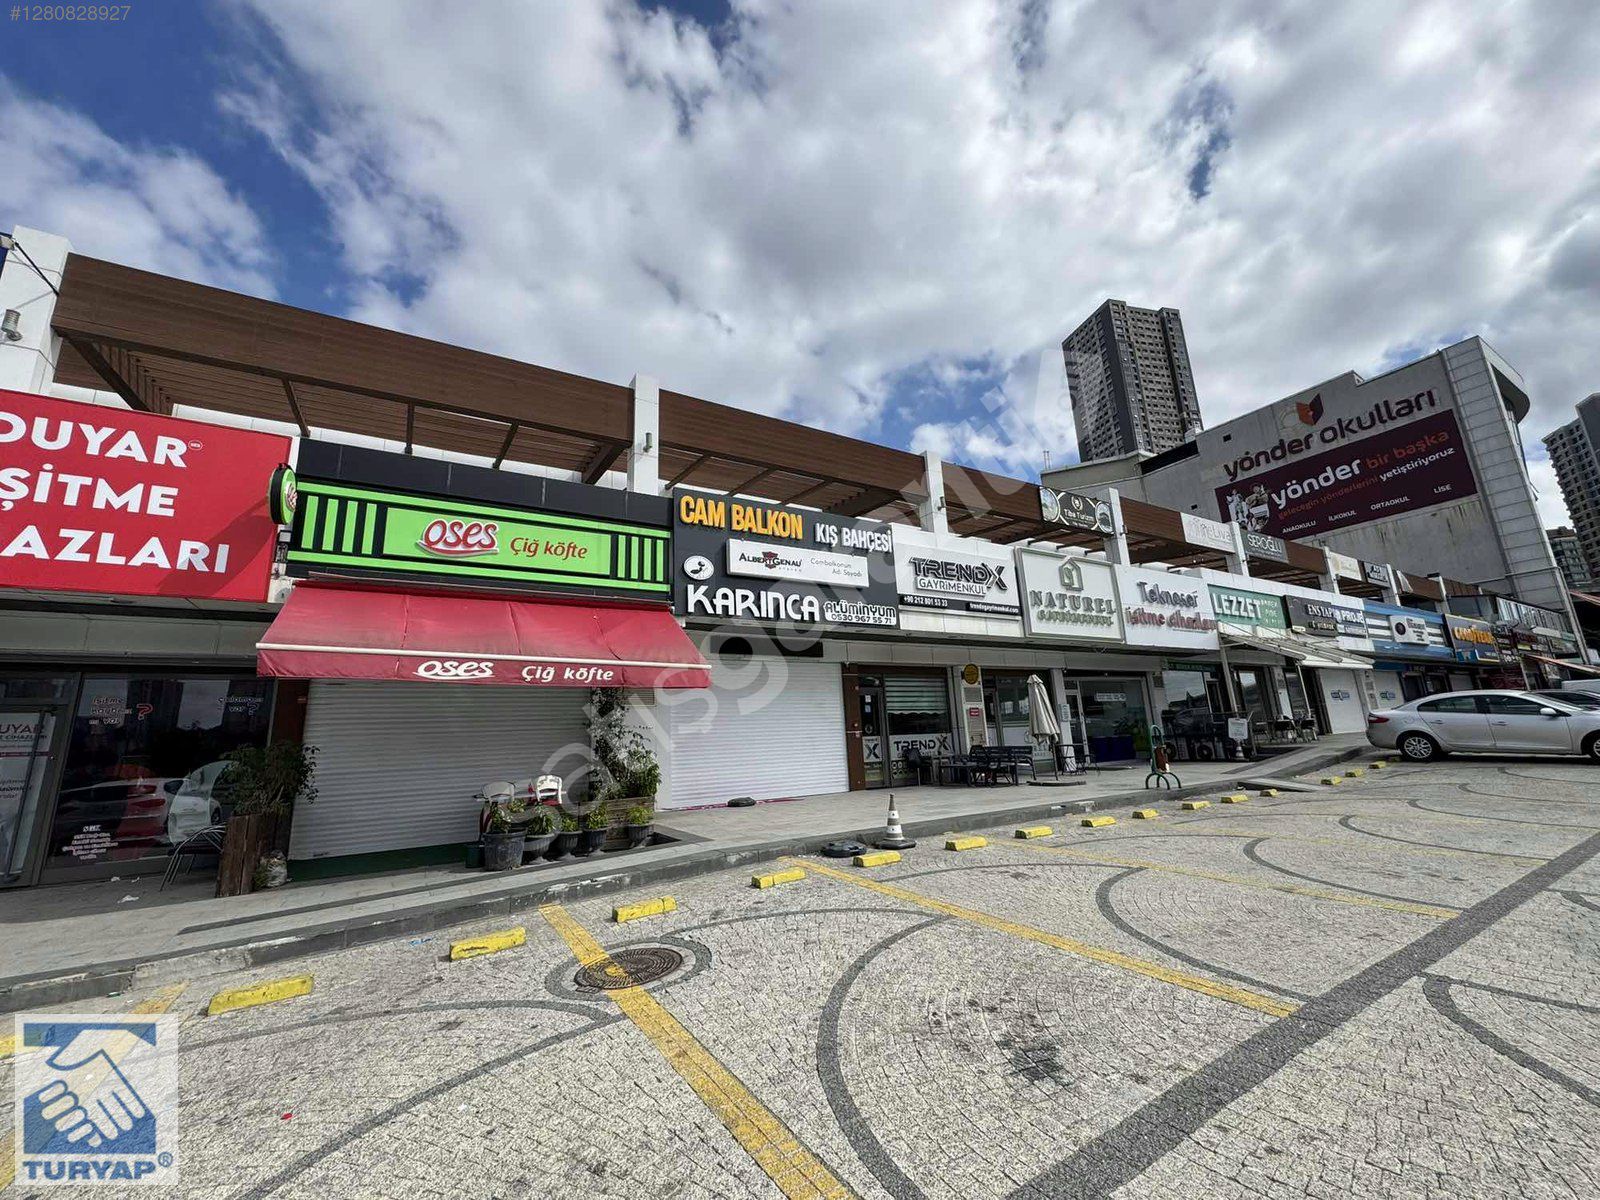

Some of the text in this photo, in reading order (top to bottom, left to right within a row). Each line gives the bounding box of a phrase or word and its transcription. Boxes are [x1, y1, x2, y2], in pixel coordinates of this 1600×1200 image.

[1224, 390, 1436, 480] yönder okulları
[1271, 430, 1450, 509] yönder bir başka
[1379, 447, 1456, 482] yetiştiriyoruz
[680, 494, 803, 540] CAM BALKON
[1282, 520, 1317, 534] ANAOKULU
[1370, 496, 1411, 511] ORTAOKUL
[1433, 483, 1453, 494] LİSE
[422, 518, 588, 561] oses Çiğ köfte
[815, 523, 893, 553] KIŞ BAHÇESİ
[687, 584, 820, 622] KARINCA
[919, 578, 987, 595] GAYRİMENKUL
[1029, 589, 1116, 615] NATUREL
[831, 613, 853, 621] 0530
[855, 615, 870, 623] 967
[872, 616, 882, 624] 55
[1212, 593, 1262, 619] LEZZET
[416, 660, 614, 683] oses Çiğ köfte
